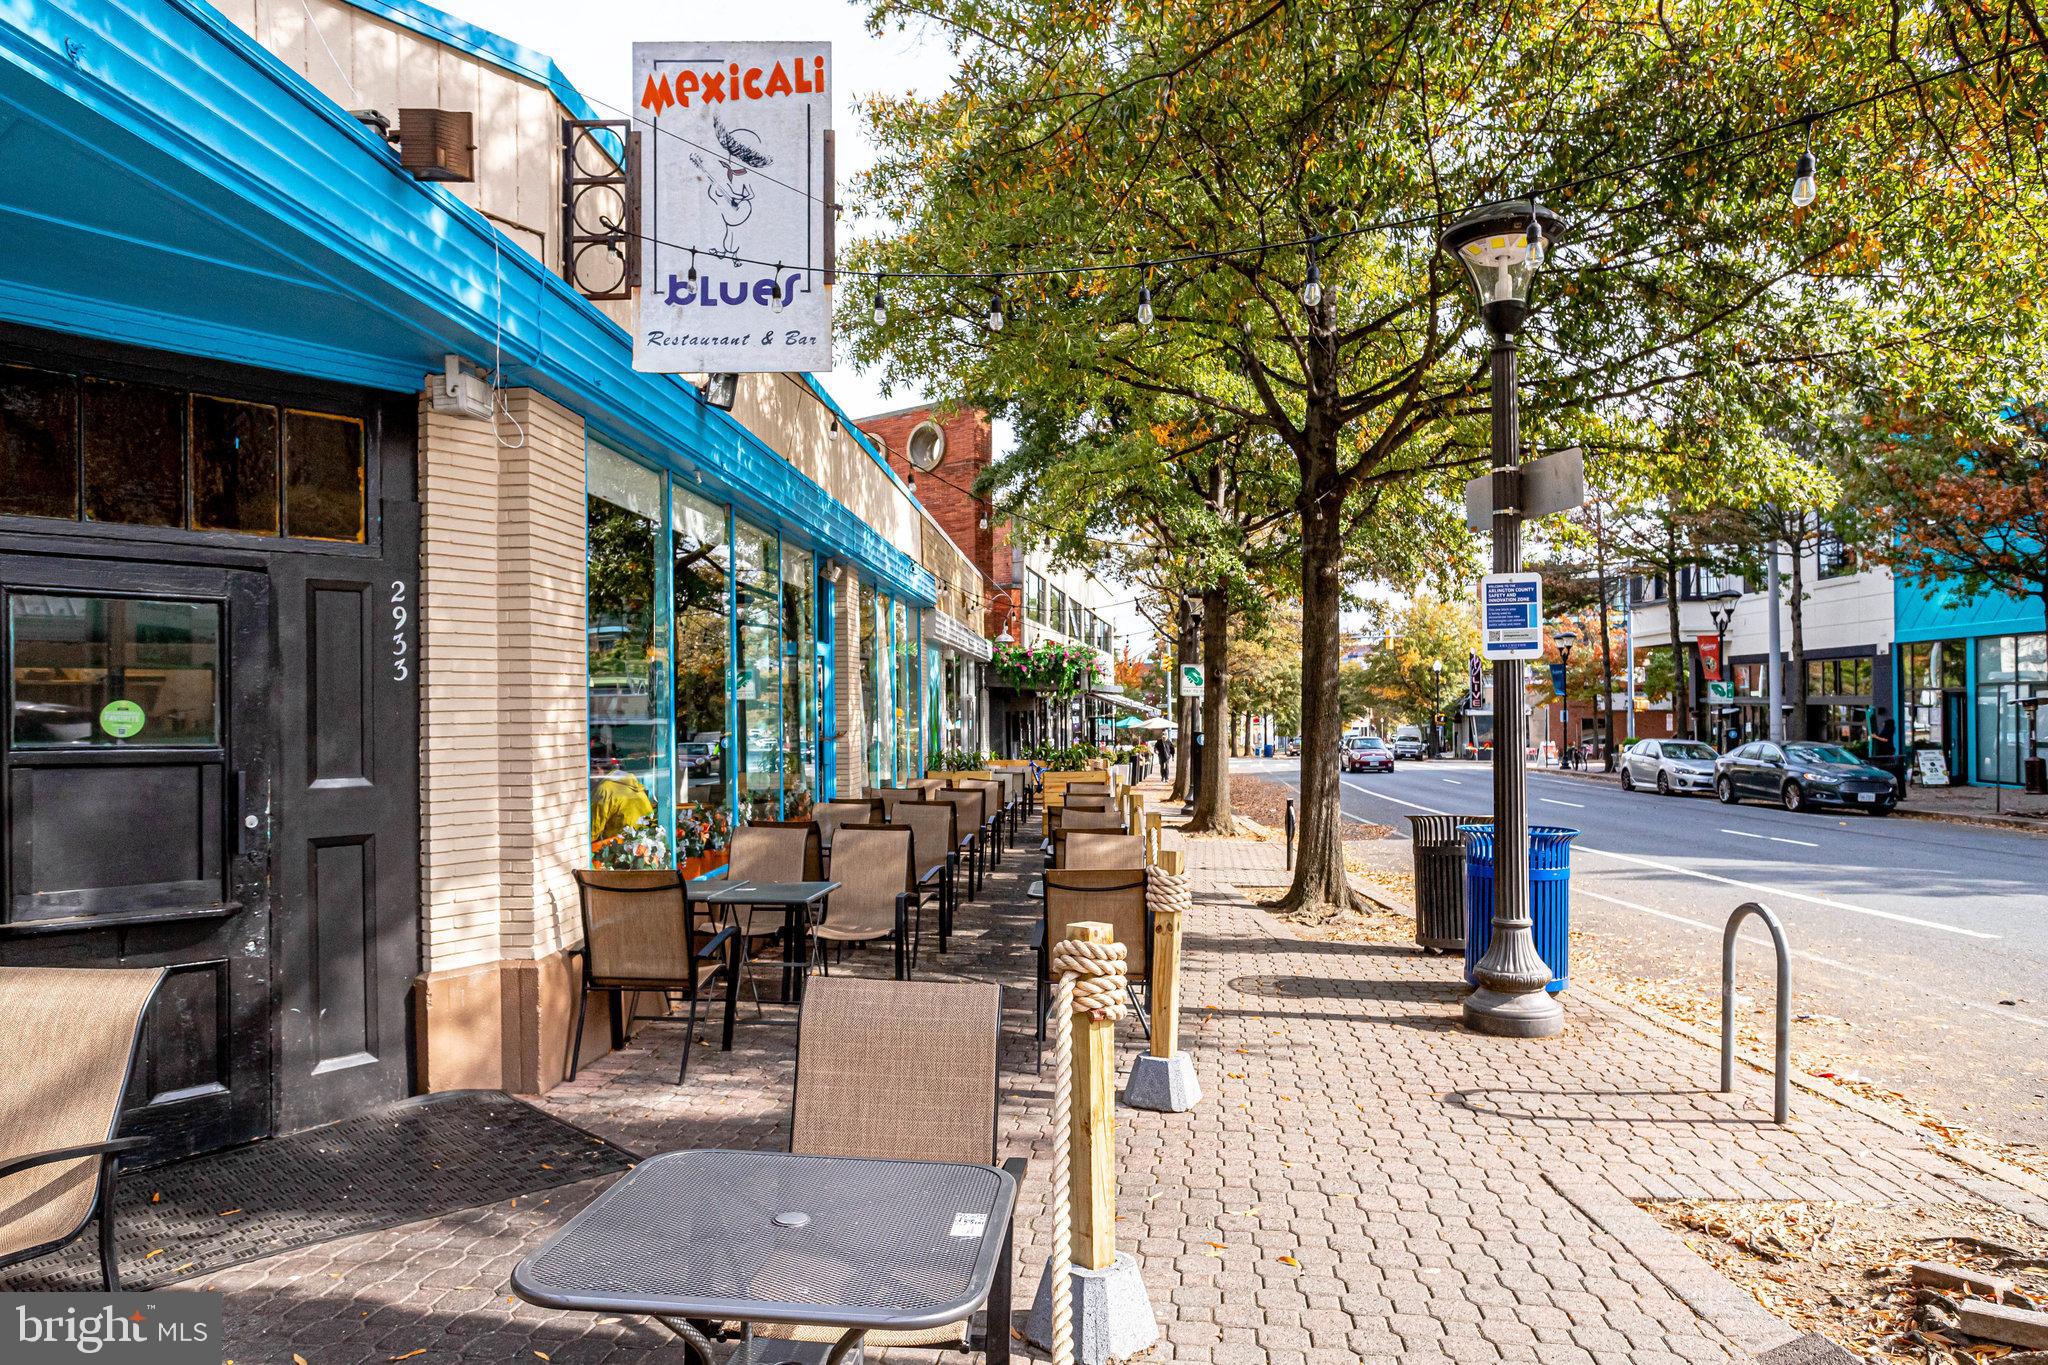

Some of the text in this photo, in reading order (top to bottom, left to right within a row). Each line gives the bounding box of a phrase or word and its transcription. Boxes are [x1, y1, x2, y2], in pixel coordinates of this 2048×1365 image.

[647, 330, 817, 347] Restaurant & Bar
[391, 580, 409, 681] 2933
